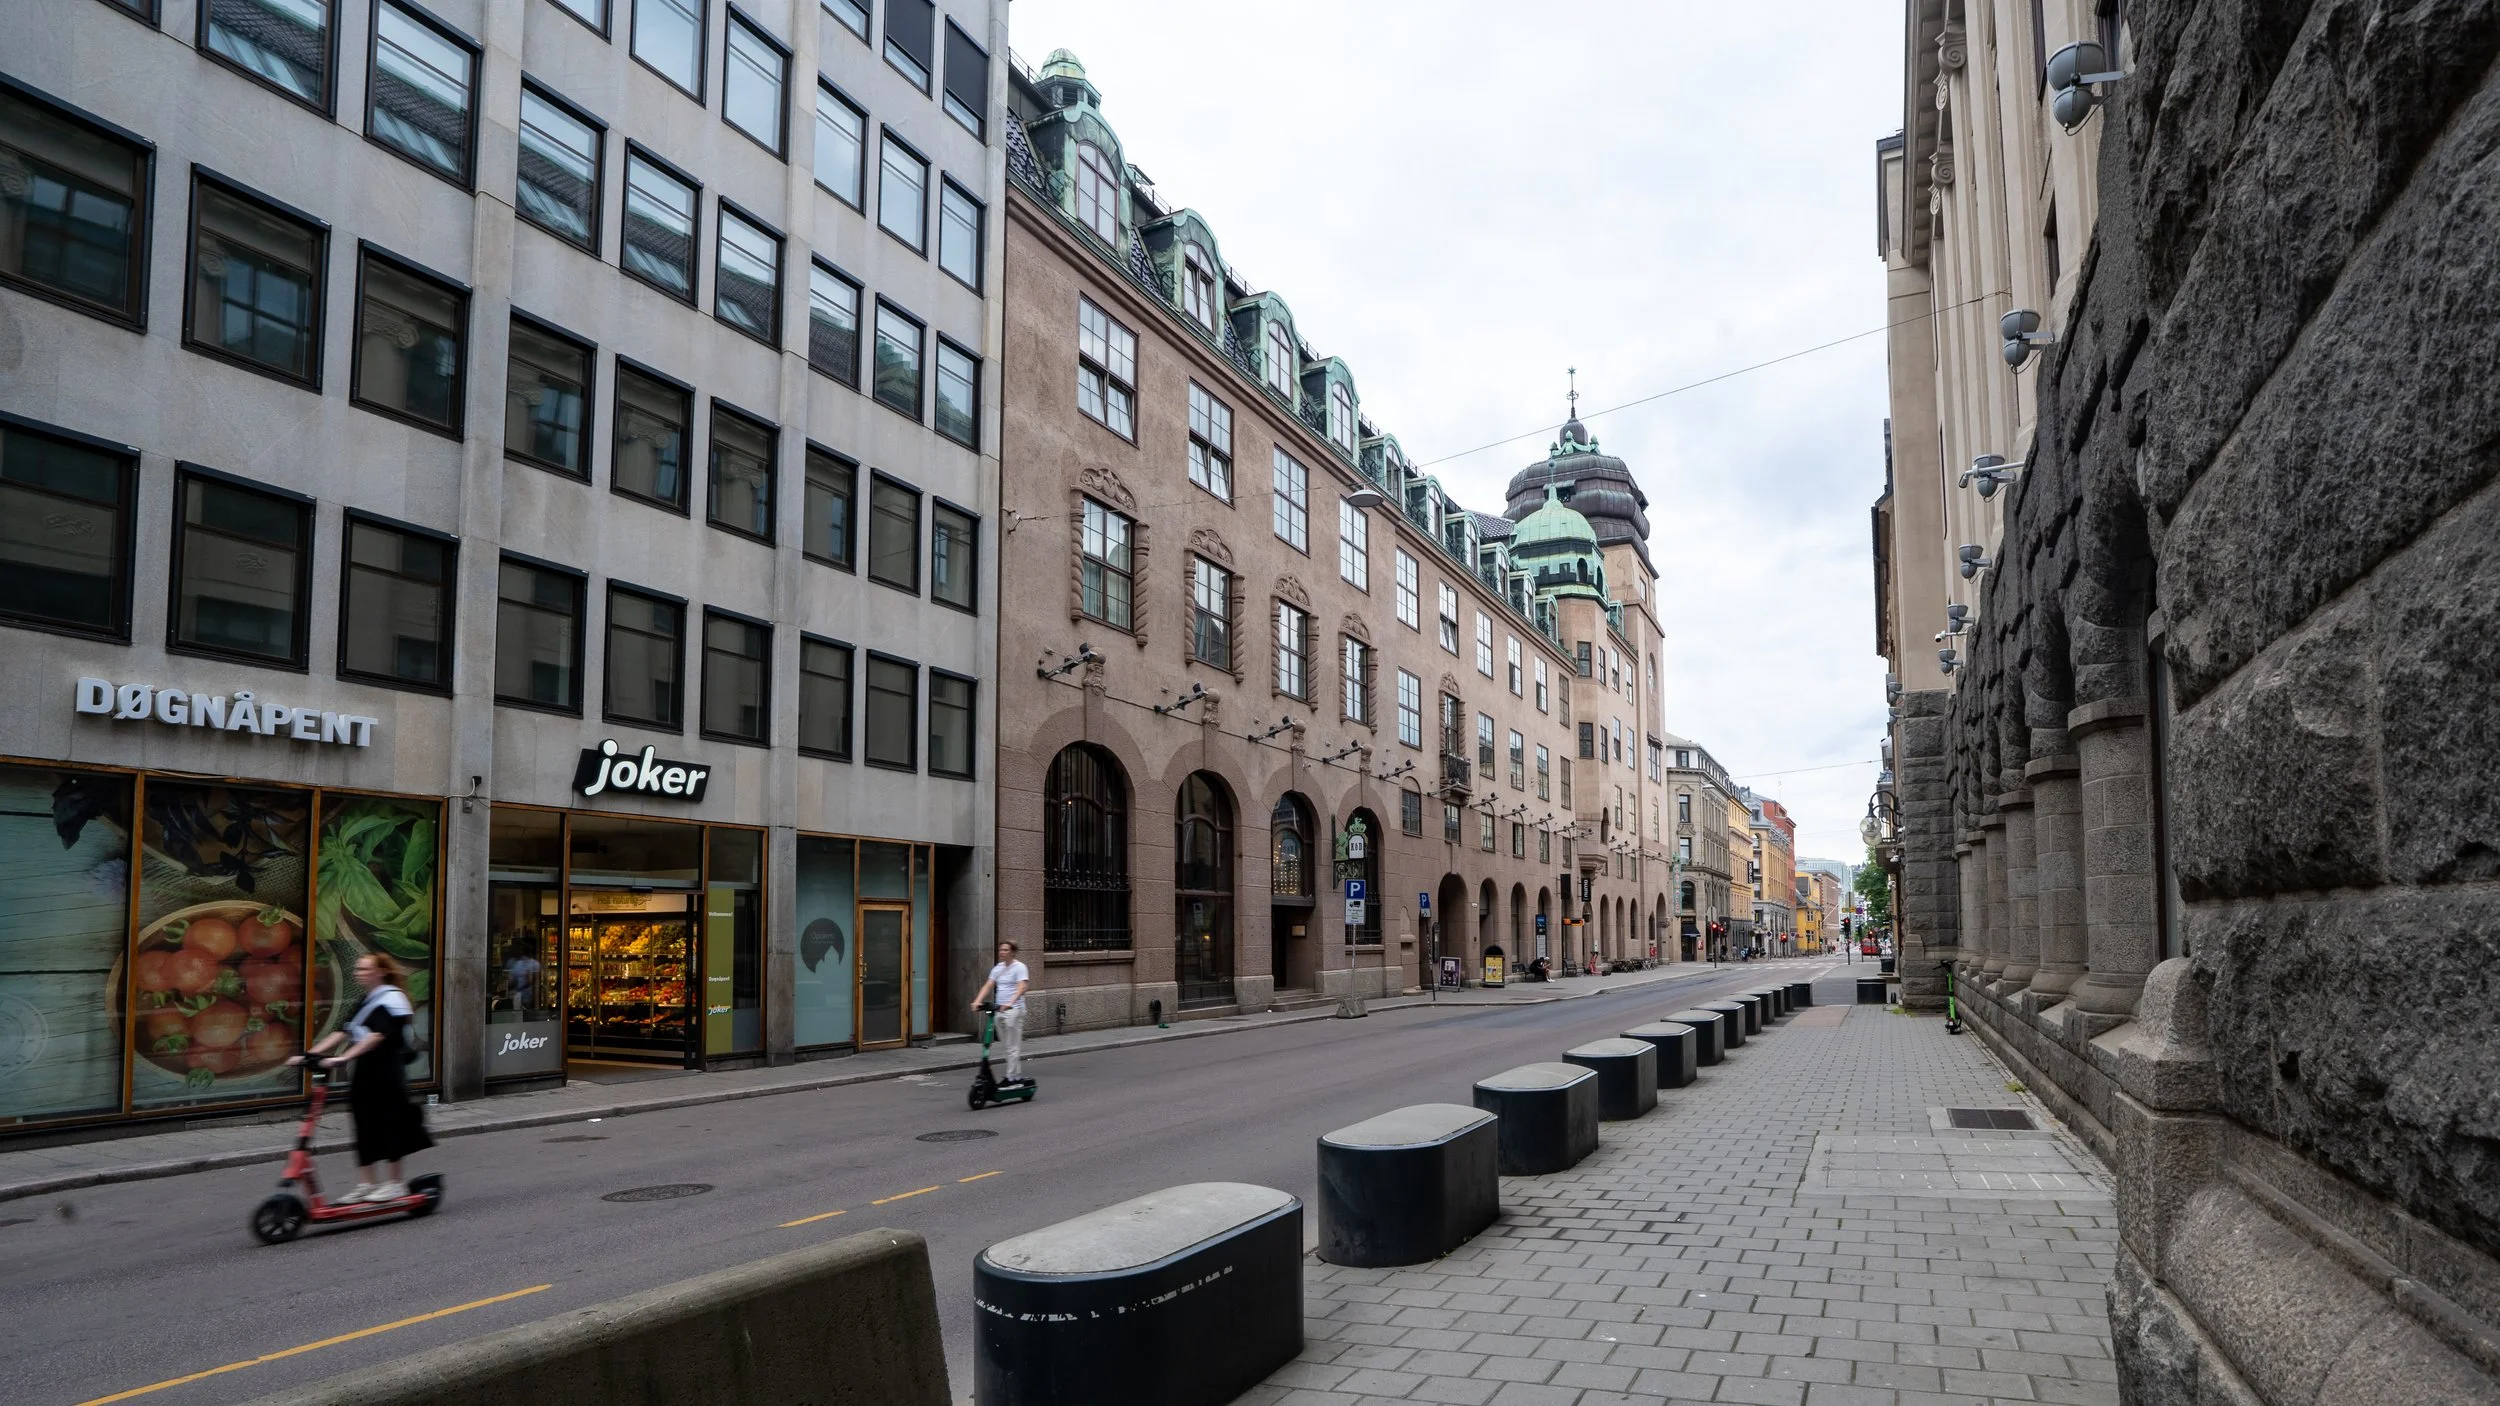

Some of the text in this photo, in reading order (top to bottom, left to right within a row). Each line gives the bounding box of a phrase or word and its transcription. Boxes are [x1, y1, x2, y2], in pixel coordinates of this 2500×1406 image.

[76, 677, 378, 747] DØGNÅPENT
[585, 739, 706, 796] joker
[1350, 882, 1361, 897] P
[1421, 894, 1427, 907] P
[498, 1031, 548, 1056] joker
